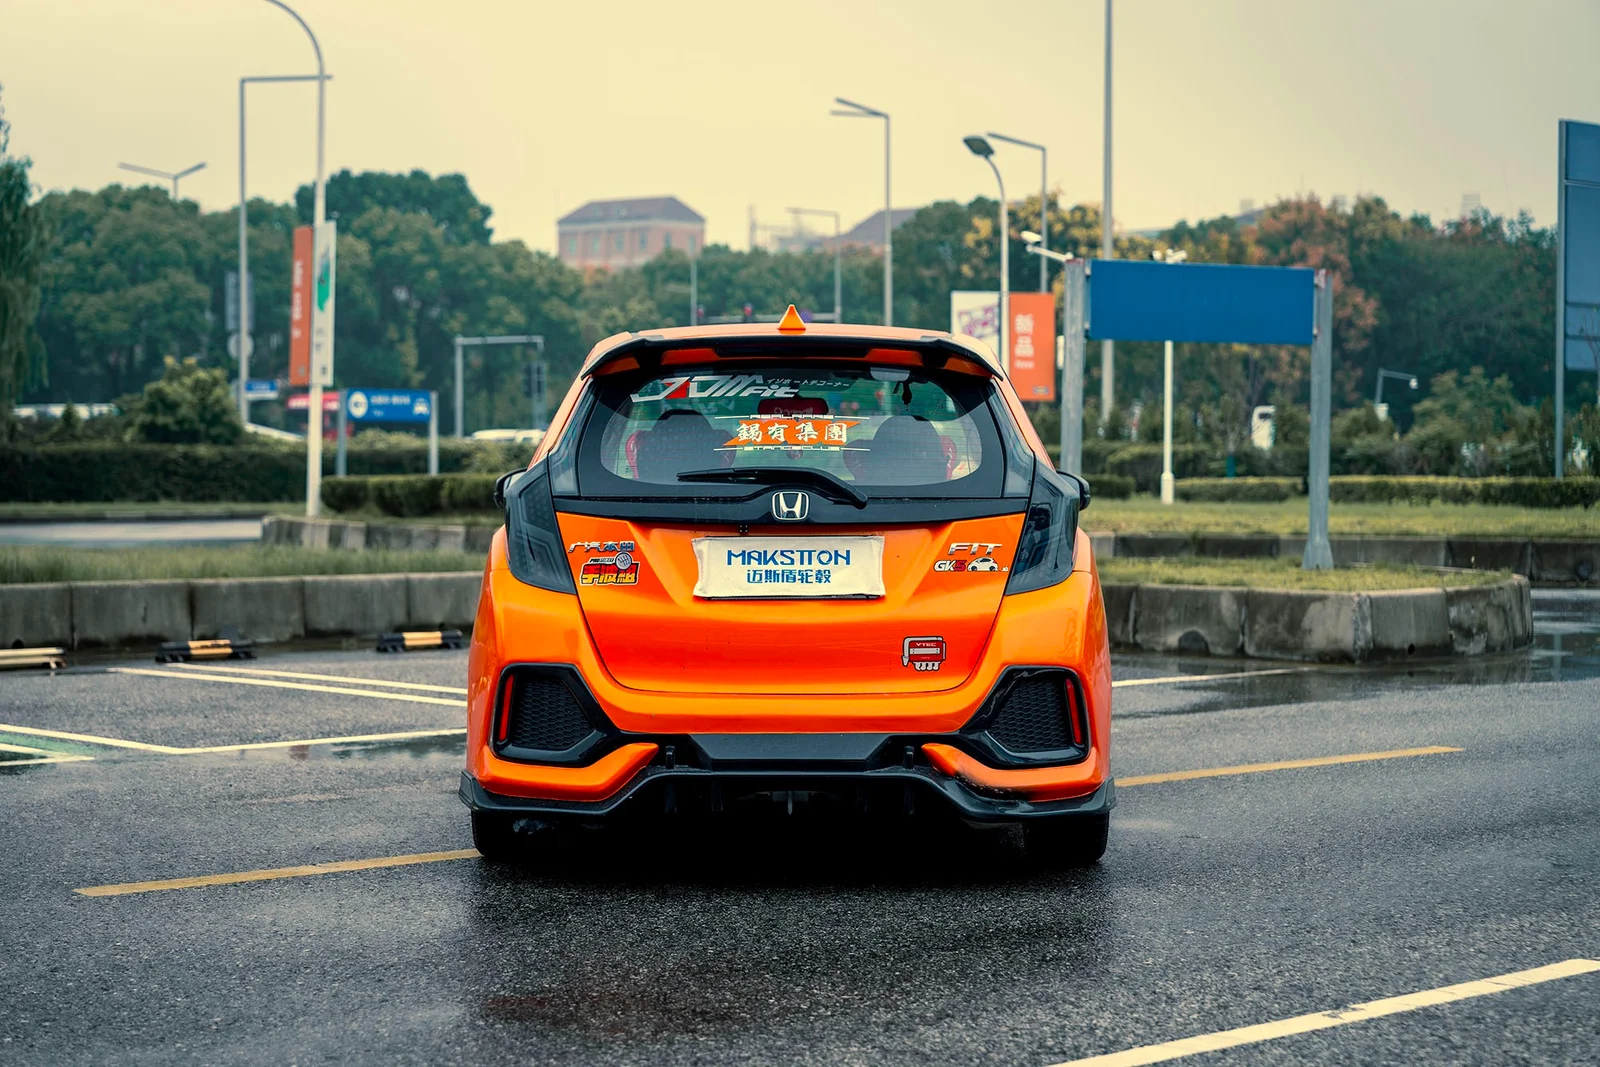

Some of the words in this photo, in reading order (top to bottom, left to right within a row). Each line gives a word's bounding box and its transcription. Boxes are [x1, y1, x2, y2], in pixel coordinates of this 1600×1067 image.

[568, 540, 635, 554] 广汽本田
[947, 542, 1003, 556] FIT
[934, 559, 967, 572] GK5
[746, 569, 832, 584] 迈斯盾轮毂
